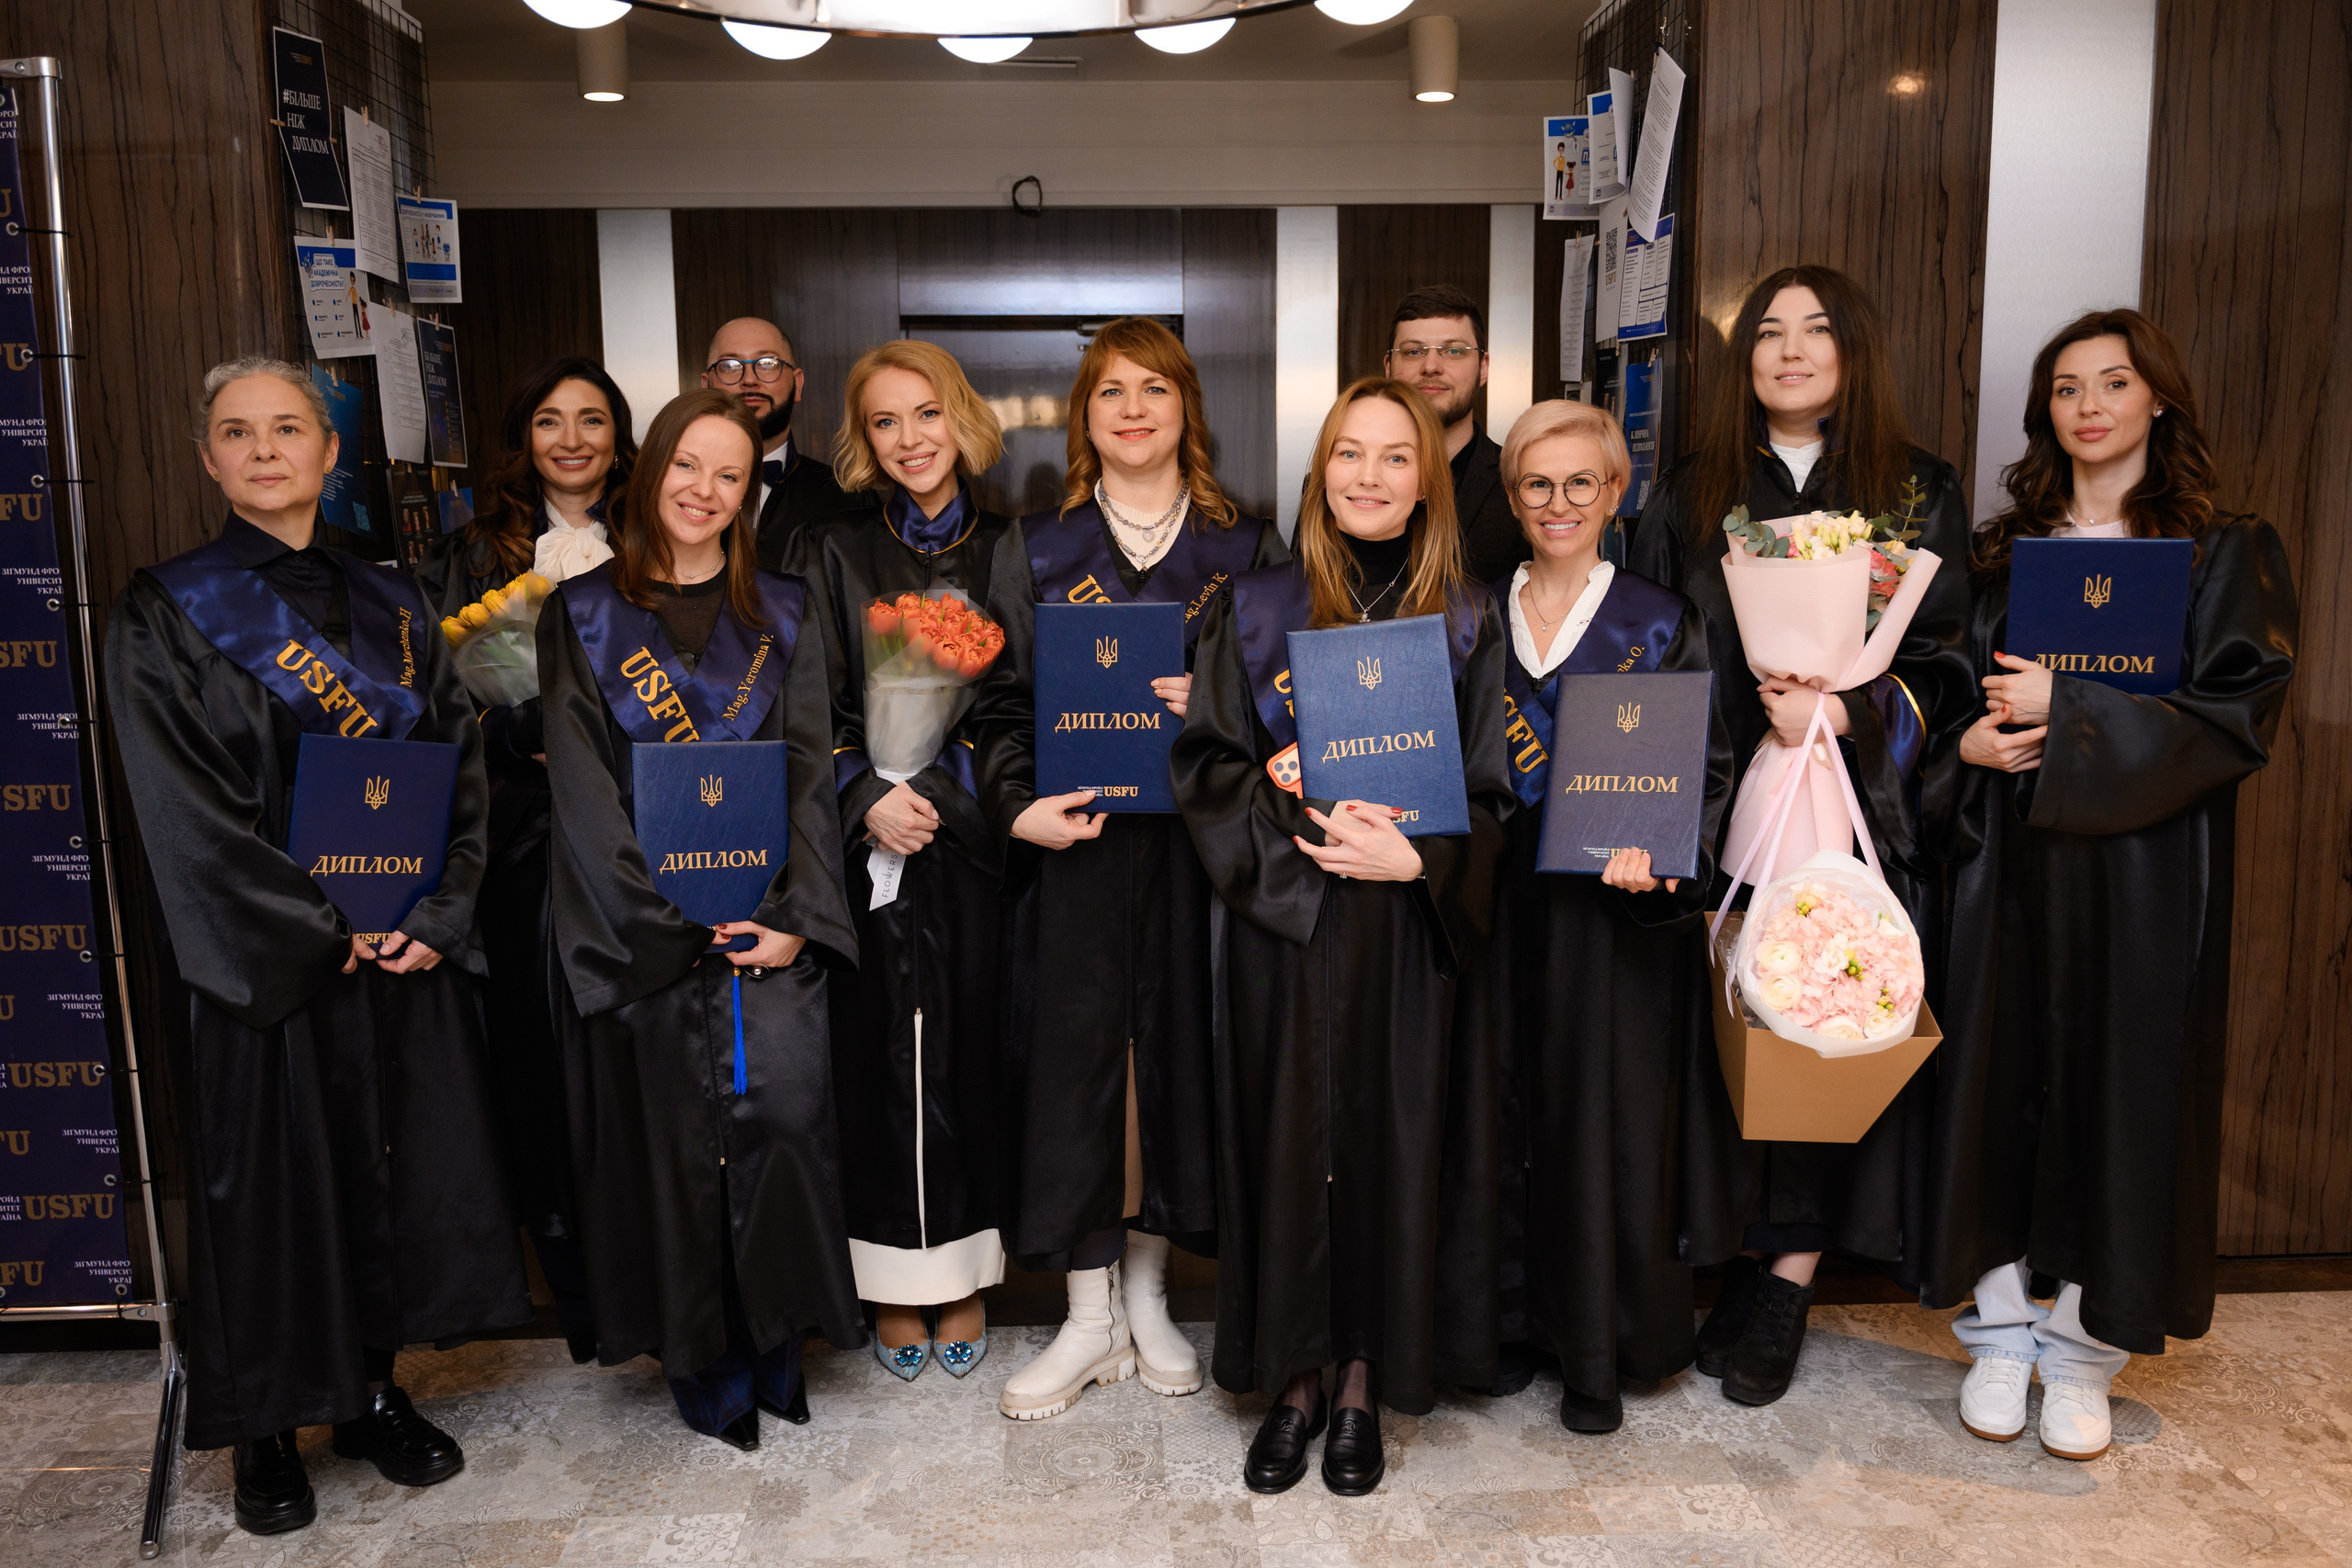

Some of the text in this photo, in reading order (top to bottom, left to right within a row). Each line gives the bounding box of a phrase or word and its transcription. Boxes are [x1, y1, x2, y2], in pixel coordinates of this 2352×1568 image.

[282, 88, 322, 110] #БІЛЬШЕ
[287, 112, 306, 130] НІЖ
[292, 135, 330, 155] ДИПЛОМ
[323, 258, 334, 266] ТАКЕ
[6, 286, 34, 295] УКРАЇ
[26, 419, 47, 427] ФРО
[22, 438, 49, 446] УКРАЇ
[37, 586, 64, 594] УКРАЇ
[1184, 571, 1228, 625] ag.Levin K.
[276, 638, 379, 738] USFU
[1054, 712, 1161, 733] ДИПЛОМ
[1503, 687, 1549, 773] SFU
[51, 731, 79, 739] УКРАЇ
[1321, 729, 1436, 763] ДИПЛОМ
[1103, 785, 1138, 797] USFU
[1566, 774, 1679, 795] ДИПЛОМ
[0, 784, 71, 811] SFU
[1394, 809, 1419, 824] SFU
[310, 855, 424, 877] ДИПЛОМ
[659, 849, 768, 874] ДИПЛОМ
[882, 854, 898, 897] FLOWERS
[0, 925, 86, 952] USFU
[7, 1061, 102, 1088] USFU
[22, 1193, 115, 1221] USFU
